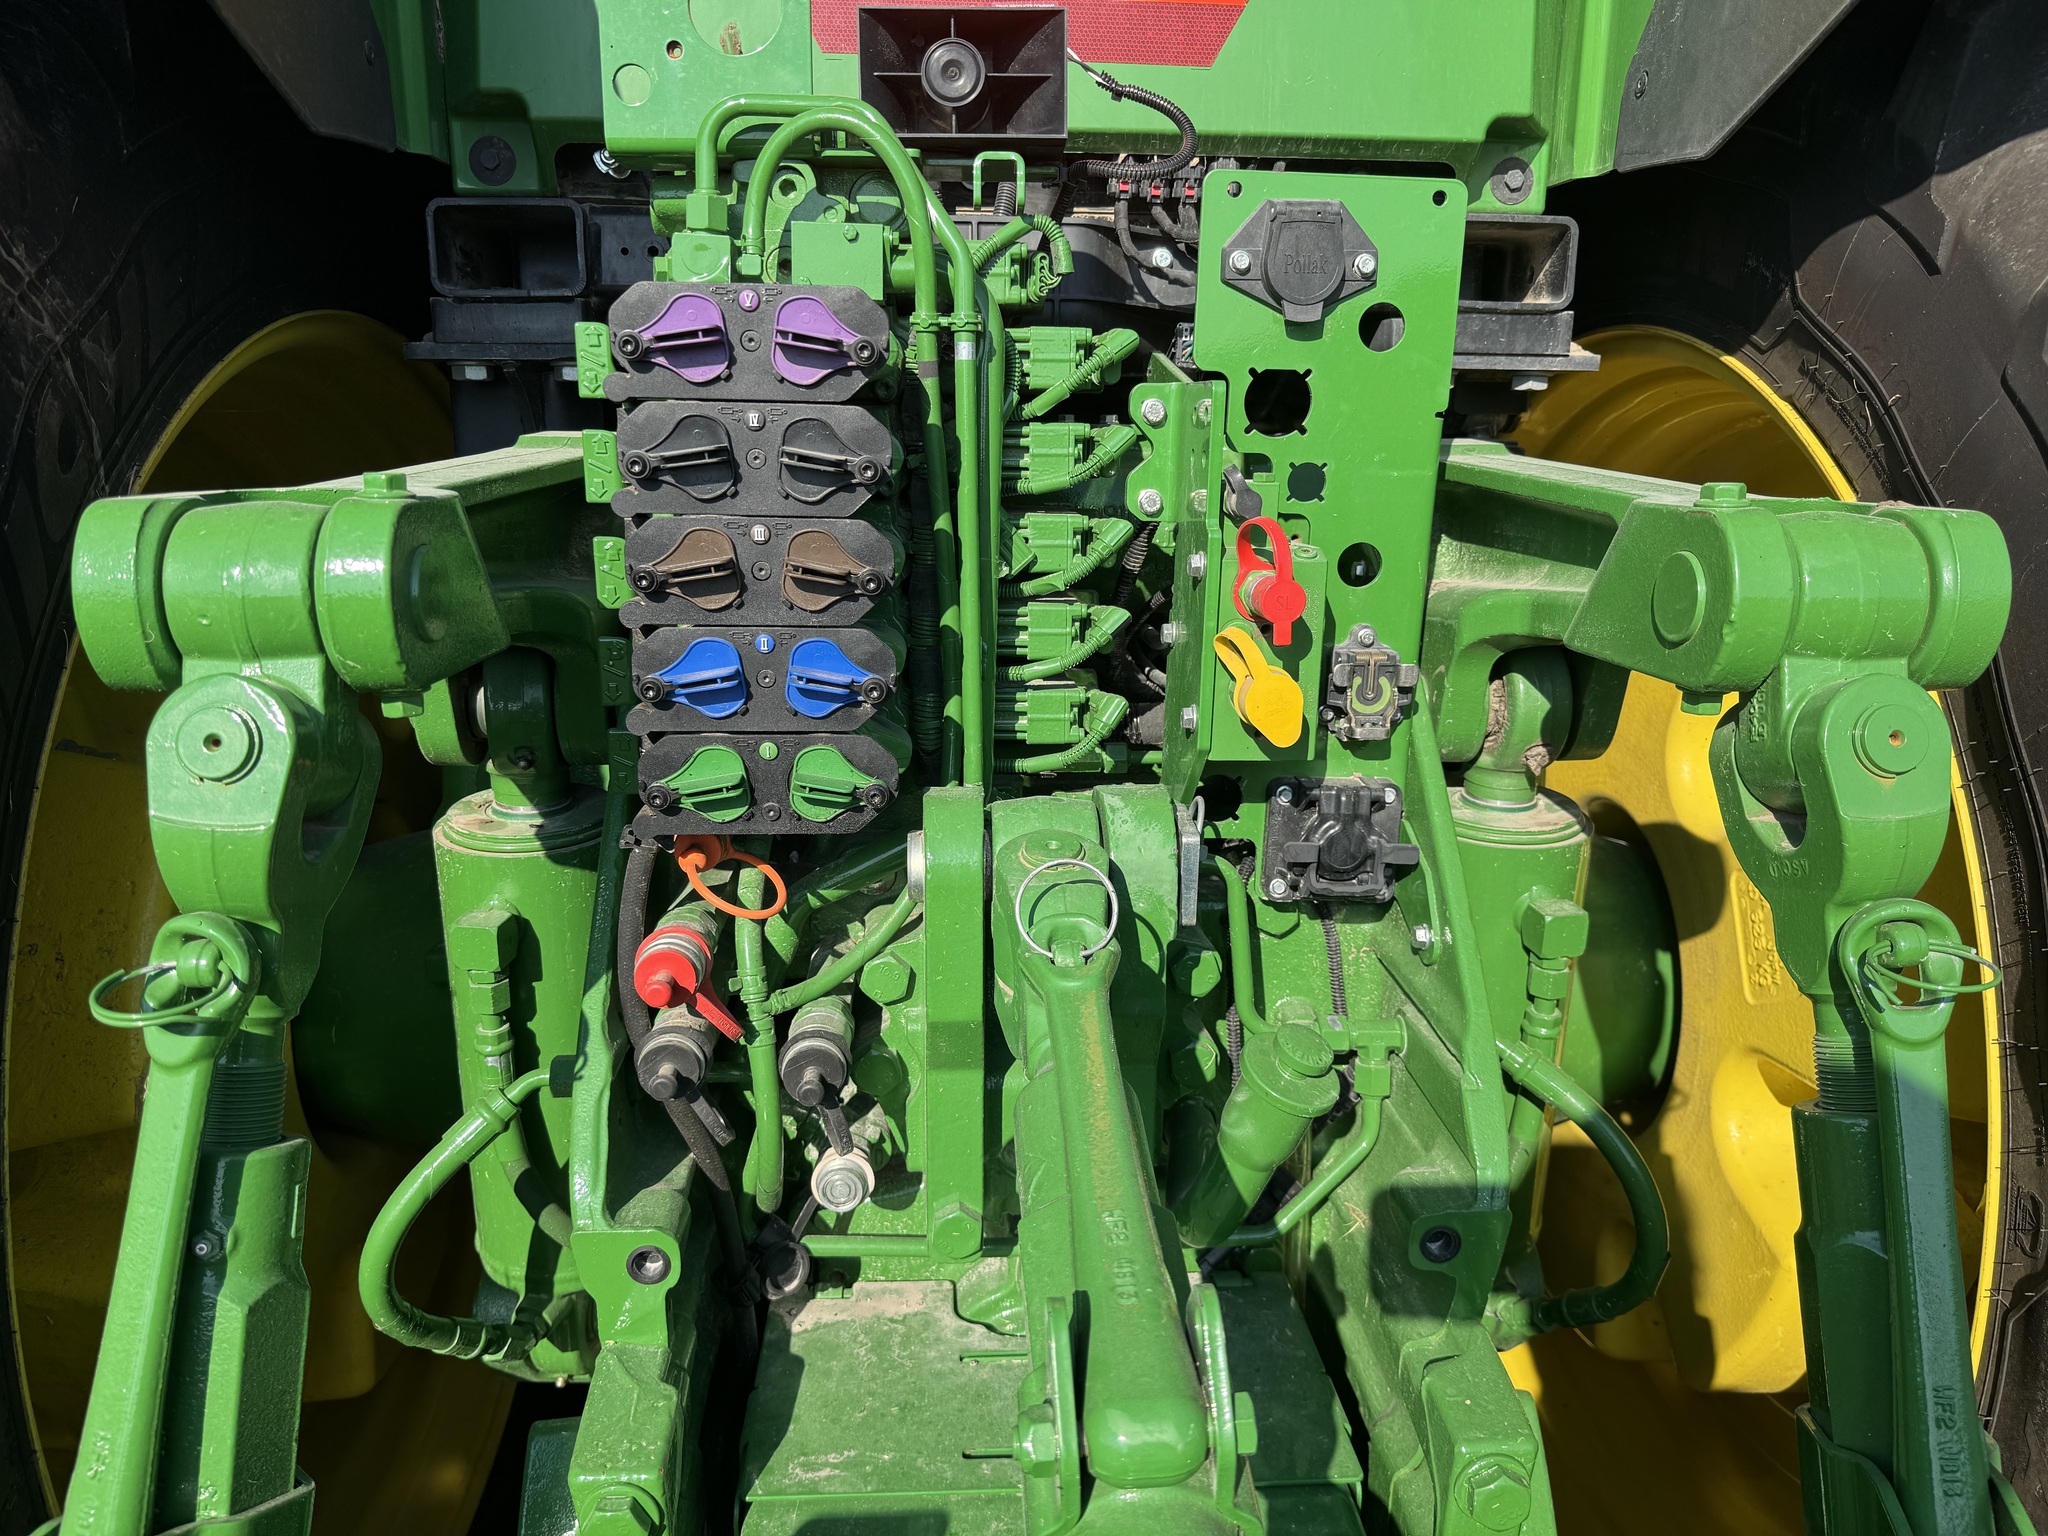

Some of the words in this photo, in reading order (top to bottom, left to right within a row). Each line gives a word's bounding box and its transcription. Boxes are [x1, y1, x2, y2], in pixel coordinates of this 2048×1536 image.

[1283, 253, 1328, 275] Pollak
[743, 293, 755, 307] V
[748, 413, 760, 427] IV
[755, 528, 766, 541] III
[1275, 595, 1293, 611] SL
[759, 638, 769, 651] II
